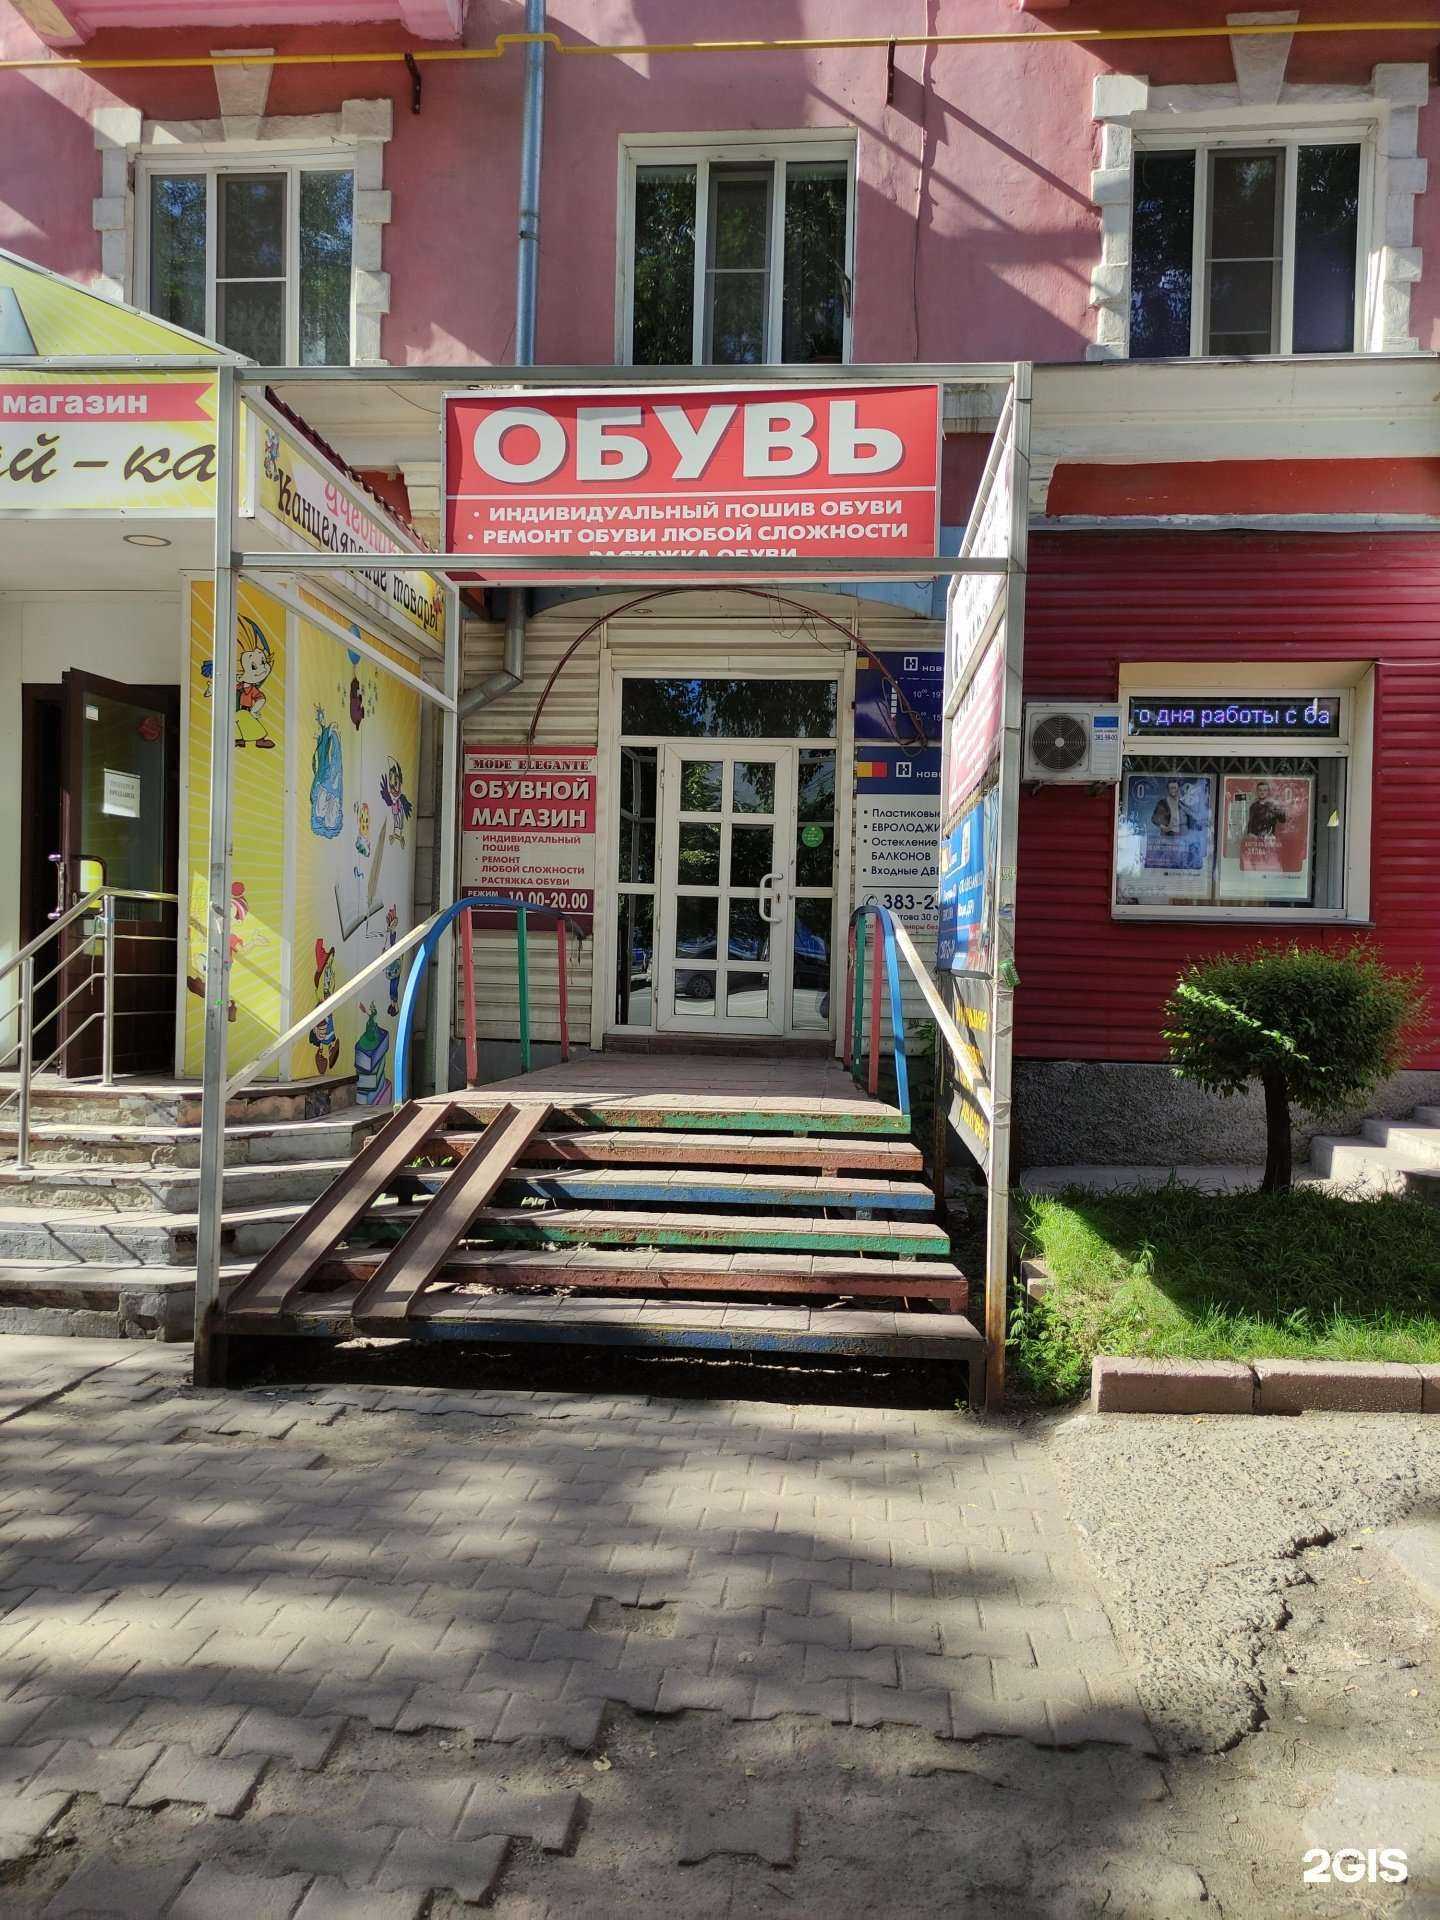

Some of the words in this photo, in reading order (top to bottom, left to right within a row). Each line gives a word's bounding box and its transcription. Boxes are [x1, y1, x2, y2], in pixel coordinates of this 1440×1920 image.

[2, 393, 149, 415] магазин
[473, 400, 905, 484] ОБУВЬ
[0, 433, 60, 483] й
[489, 502, 719, 523] ИНДИВИДУАЛЬНЫЙ
[725, 502, 815, 518] ПОШИВ
[820, 499, 902, 516] ОБУВИ
[483, 528, 573, 544] РЕМОНТ
[577, 527, 656, 543] ОБУВИ
[661, 523, 752, 542] ЛЮБОЙ
[757, 523, 908, 541] СЛОЖНОСТИ
[393, 571, 439, 632] товары
[1156, 709, 1194, 726] дня
[1201, 705, 1279, 728] работы
[1286, 710, 1297, 724] с
[473, 760, 512, 769] MODE
[518, 760, 589, 770] ELEGANTE
[469, 778, 589, 800] ОБУВНОЙ
[472, 807, 586, 828] МАГАЗИН
[482, 835, 581, 844] ИНДИВИДУАЛЬНЫЙ
[482, 844, 520, 852] ПОШИВ
[871, 837, 938, 847] Остекление
[482, 856, 520, 864] РЕМОНТ
[871, 851, 931, 861] БАЛКОНОВ
[481, 865, 520, 874] ЛЮБОЙ
[522, 866, 585, 874] СЛОЖНОСТИ
[871, 865, 919, 876] Входные
[481, 877, 534, 885] РАСТЯЖКА
[535, 878, 570, 886] ОБУВИ
[508, 891, 588, 910] 1000-20.00
[882, 894, 939, 910] 383-2
